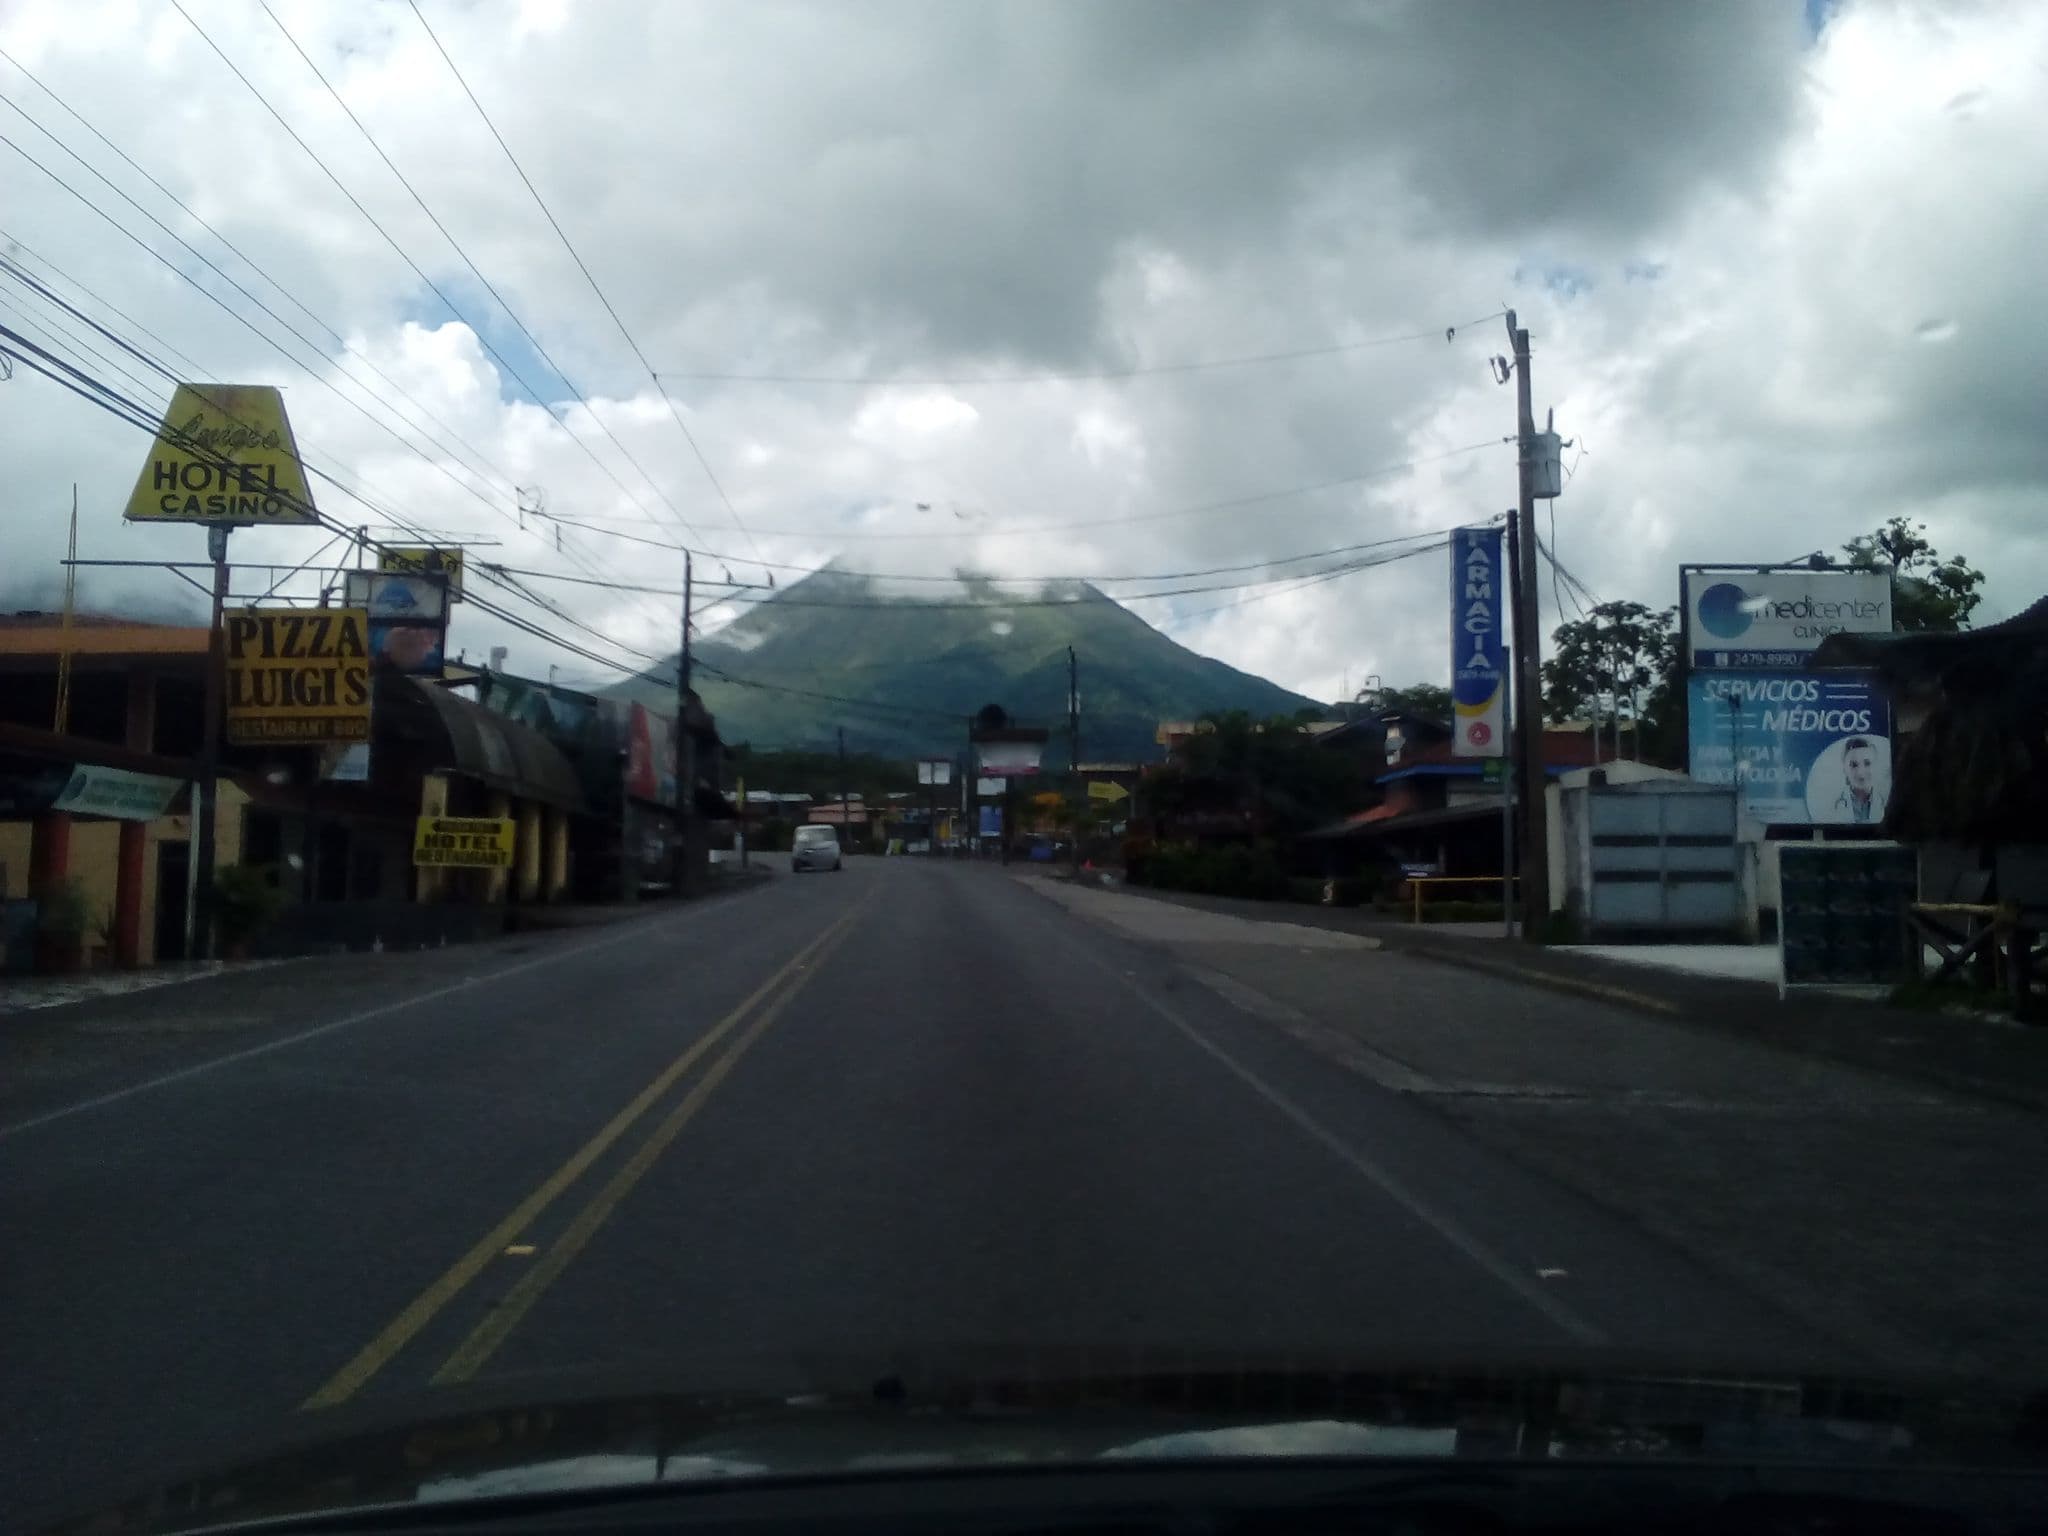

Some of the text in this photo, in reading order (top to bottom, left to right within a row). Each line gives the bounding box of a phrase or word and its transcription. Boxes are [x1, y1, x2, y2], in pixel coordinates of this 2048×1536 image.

[153, 461, 290, 494] HOTEL
[160, 494, 281, 515] CASINO
[1464, 531, 1492, 669] FARMACIA
[229, 616, 365, 658] PIZZA
[228, 660, 368, 707] LUIGI'S
[1702, 679, 1820, 703] SERVICIOS
[1761, 703, 1872, 733] MÉDICOS
[424, 834, 503, 850] HOTEL
